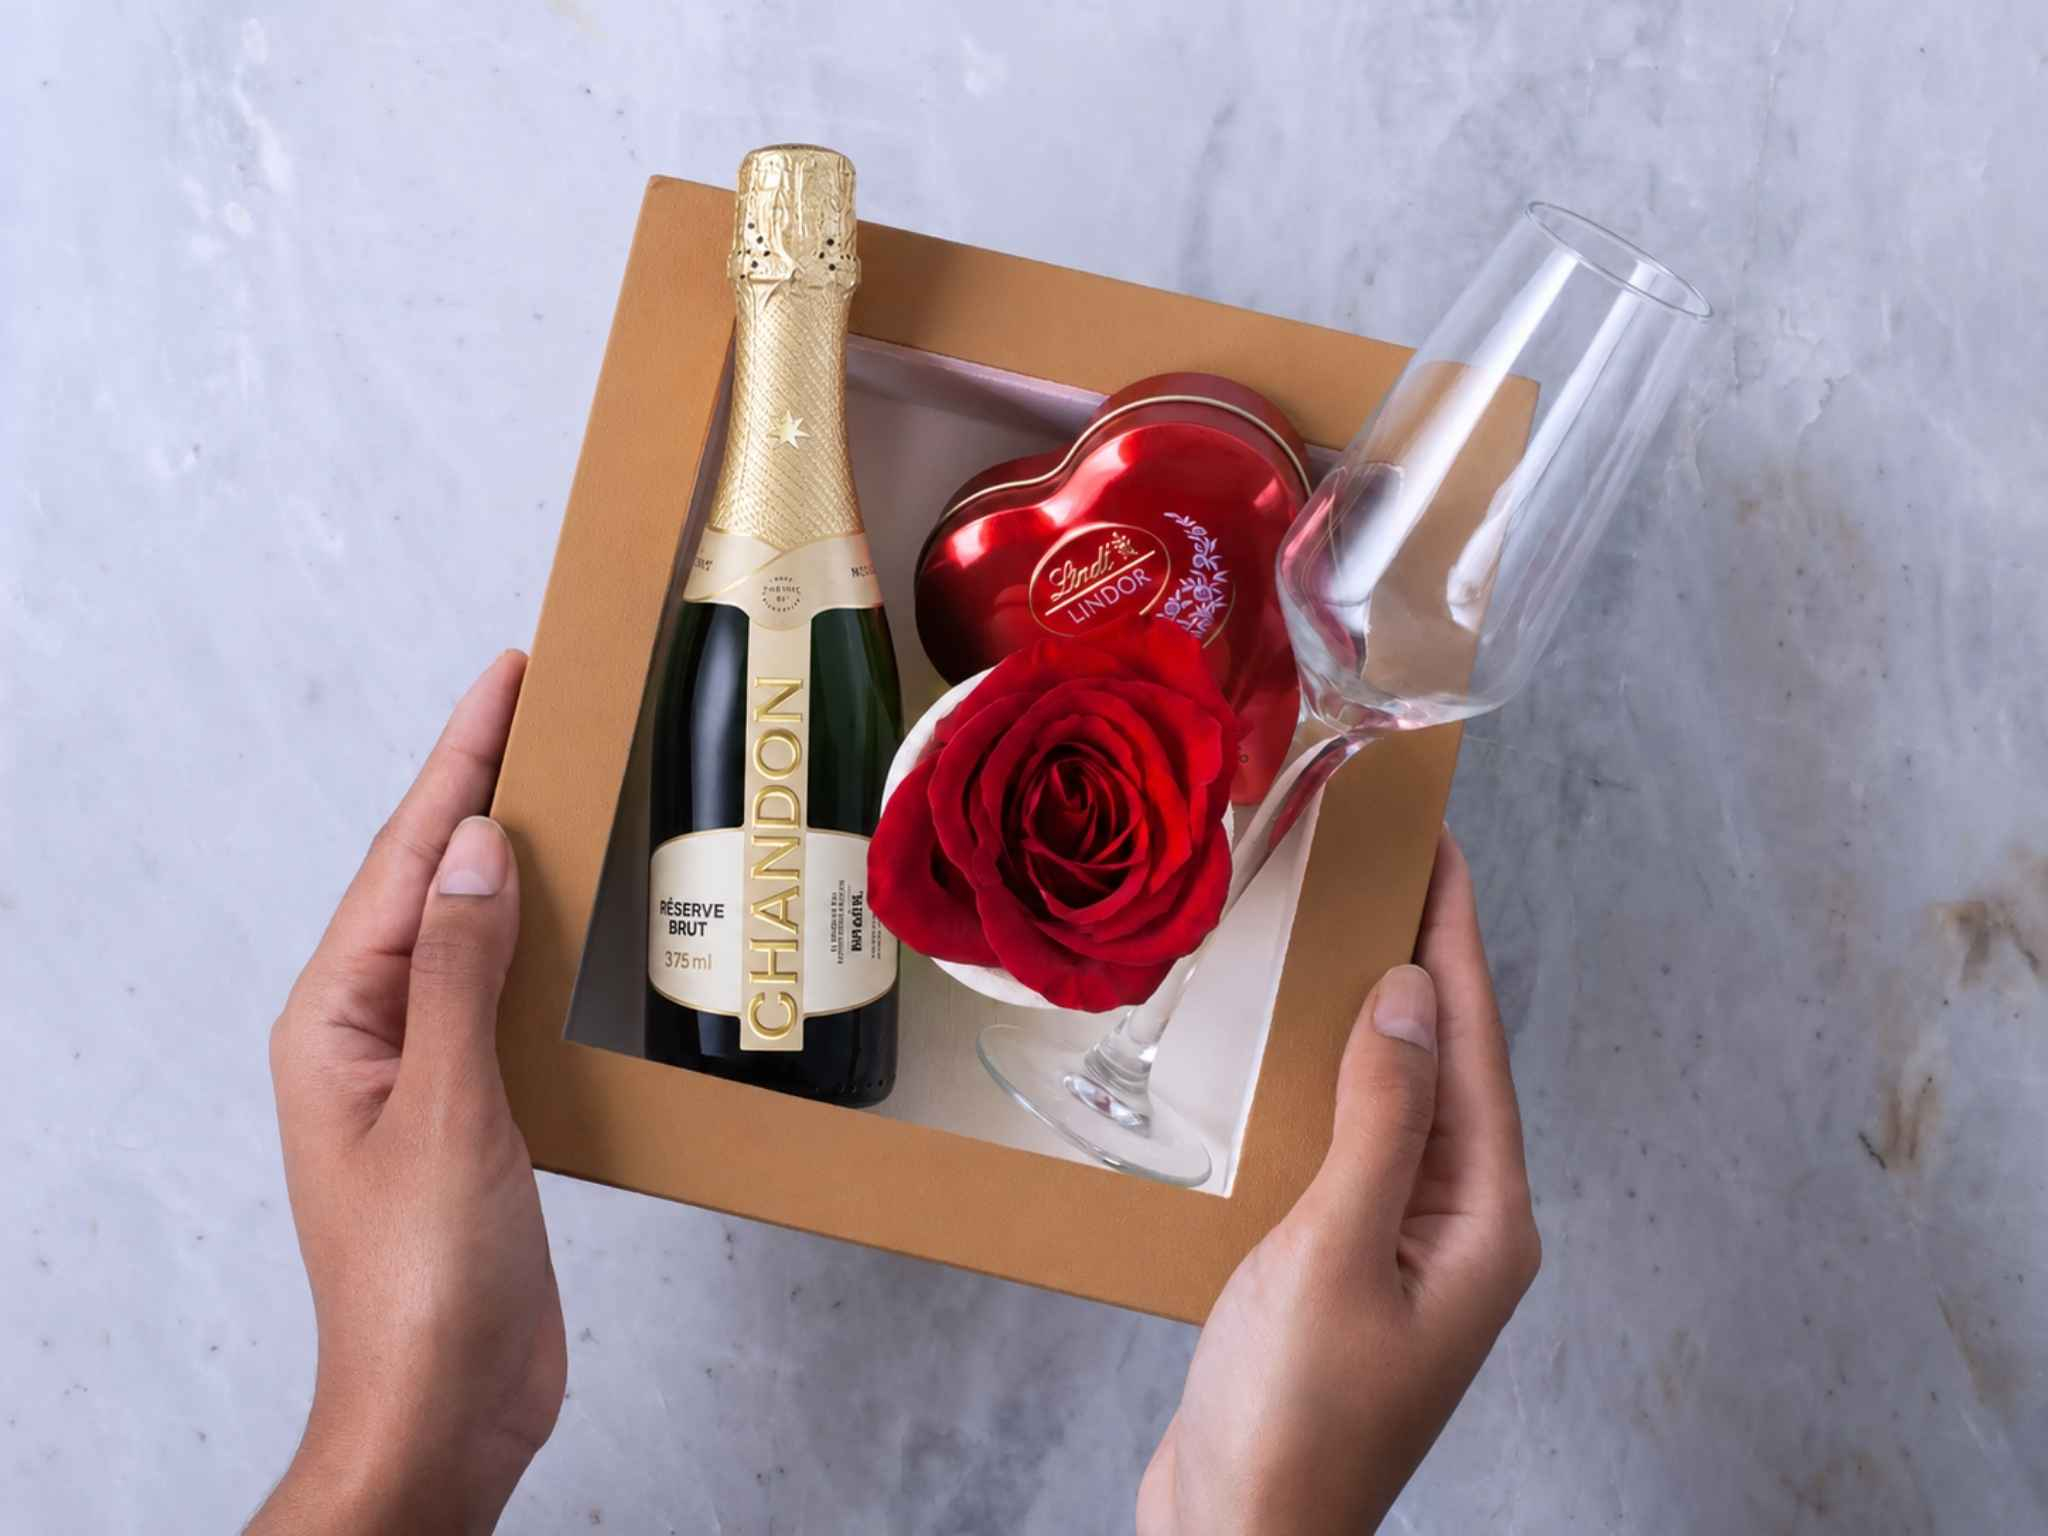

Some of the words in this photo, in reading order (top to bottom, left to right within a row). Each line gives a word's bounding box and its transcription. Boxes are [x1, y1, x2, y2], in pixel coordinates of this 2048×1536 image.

[1049, 542, 1114, 602] Lindt
[1067, 568, 1152, 624] LINDOR
[748, 676, 803, 1040] CHANDON
[659, 896, 725, 919] RÉSERVE
[669, 919, 708, 937] BRUT
[664, 950, 690, 969] 375
[692, 953, 713, 970] ml
